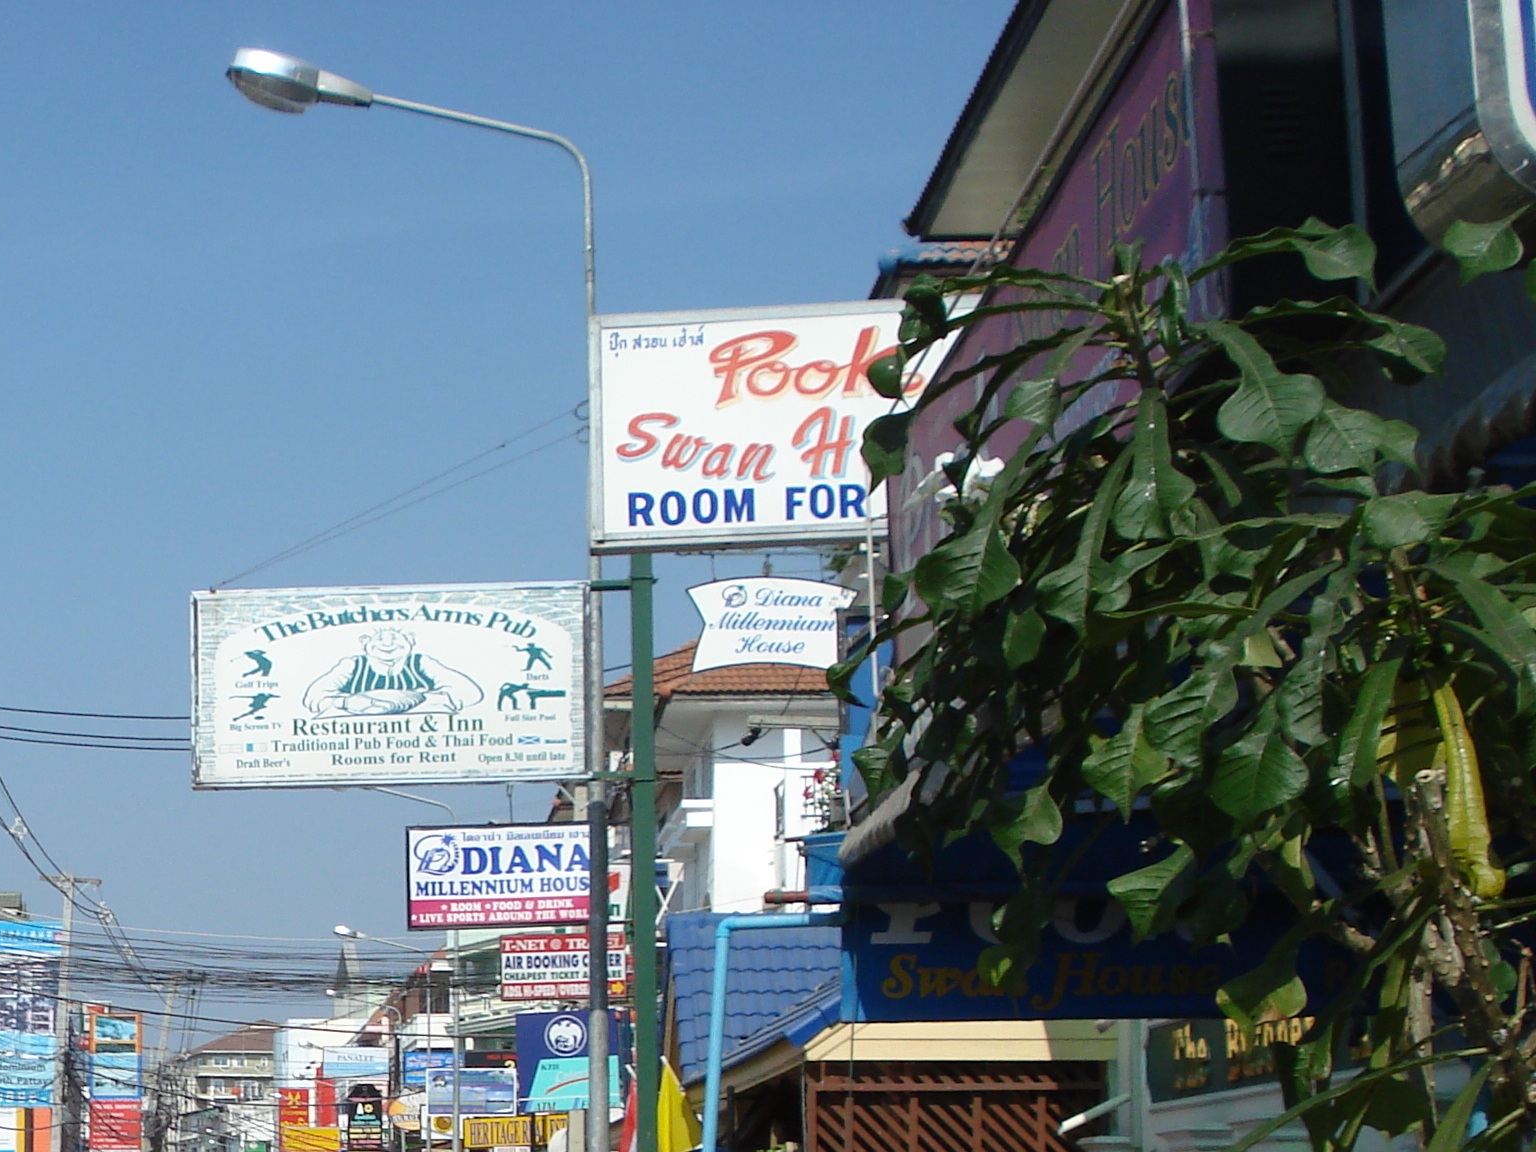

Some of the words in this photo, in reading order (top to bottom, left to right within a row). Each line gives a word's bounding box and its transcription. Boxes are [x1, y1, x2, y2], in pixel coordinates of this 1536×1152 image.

[616, 412, 777, 484] Swan
[627, 488, 756, 527] ROOM
[785, 483, 866, 521] FOR
[754, 587, 824, 608] Diana
[254, 620, 307, 643] The
[306, 605, 410, 631] Butchers
[411, 604, 484, 627] Arms
[484, 610, 537, 639] Pub
[708, 611, 836, 632] Millennium
[735, 633, 806, 655] House
[292, 717, 412, 736] Restaurant
[419, 714, 439, 733] &
[448, 714, 485, 732] Inn
[271, 737, 350, 752] Traditional
[354, 737, 382, 750] Pub
[386, 735, 421, 750] Food
[425, 735, 438, 748] &
[442, 734, 475, 748] Thai
[479, 733, 514, 747] Food
[236, 758, 261, 769] Draft
[331, 753, 385, 766] Rooms
[390, 752, 414, 764] for
[419, 750, 457, 763] Rent
[478, 752, 503, 765] Open
[526, 751, 547, 762] until
[550, 750, 567, 761] late
[460, 843, 590, 876] DIANA
[415, 877, 534, 897] MILLENNIUM
[540, 875, 590, 893] HOUS
[419, 912, 444, 924] LIVE
[447, 911, 486, 923] SPORTS
[489, 910, 533, 922] AROUND
[536, 909, 557, 921] THE
[559, 908, 590, 920] WORL
[450, 902, 482, 913] ROOM
[492, 900, 523, 911] FOOD
[538, 898, 574, 910] DRINK
[504, 955, 524, 970] AIR
[527, 954, 579, 969] BOOKING
[504, 971, 547, 981] CHEAPEST
[551, 971, 580, 980] TICKET
[470, 1121, 520, 1146] HERITAGE
